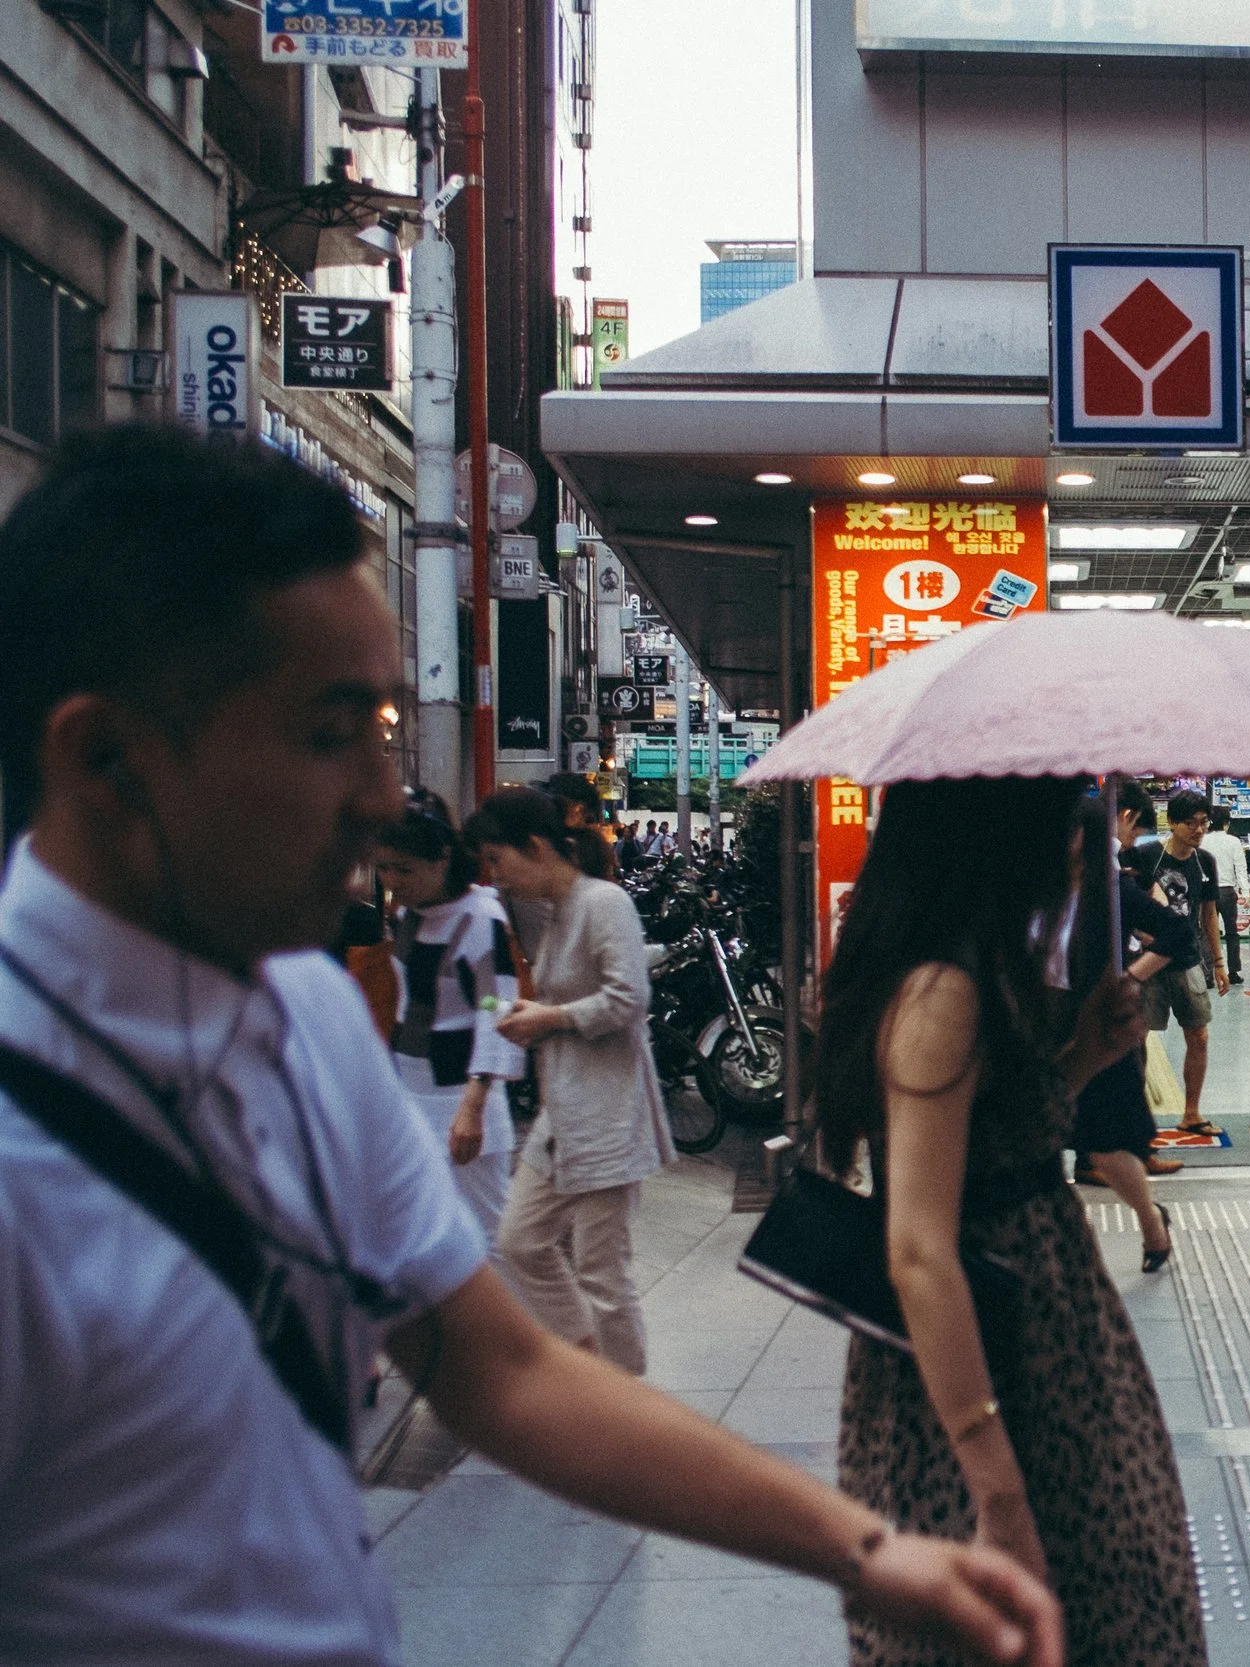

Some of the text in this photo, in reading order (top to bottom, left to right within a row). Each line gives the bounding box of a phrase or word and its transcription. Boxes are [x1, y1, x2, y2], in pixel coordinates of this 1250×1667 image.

[301, 15, 445, 37] 03-3352-7325
[305, 37, 457, 59] 手前もどる 買取
[297, 305, 371, 337] モア
[600, 321, 624, 335] 4F
[300, 346, 369, 363] 中央通り
[207, 325, 246, 431] okad
[834, 535, 929, 551] Welcome!
[504, 560, 532, 577] BNE
[844, 570, 860, 596] Our
[997, 584, 1017, 597] Card
[1001, 576, 1027, 592] Credit
[638, 658, 662, 669] モア
[845, 647, 861, 663] of
